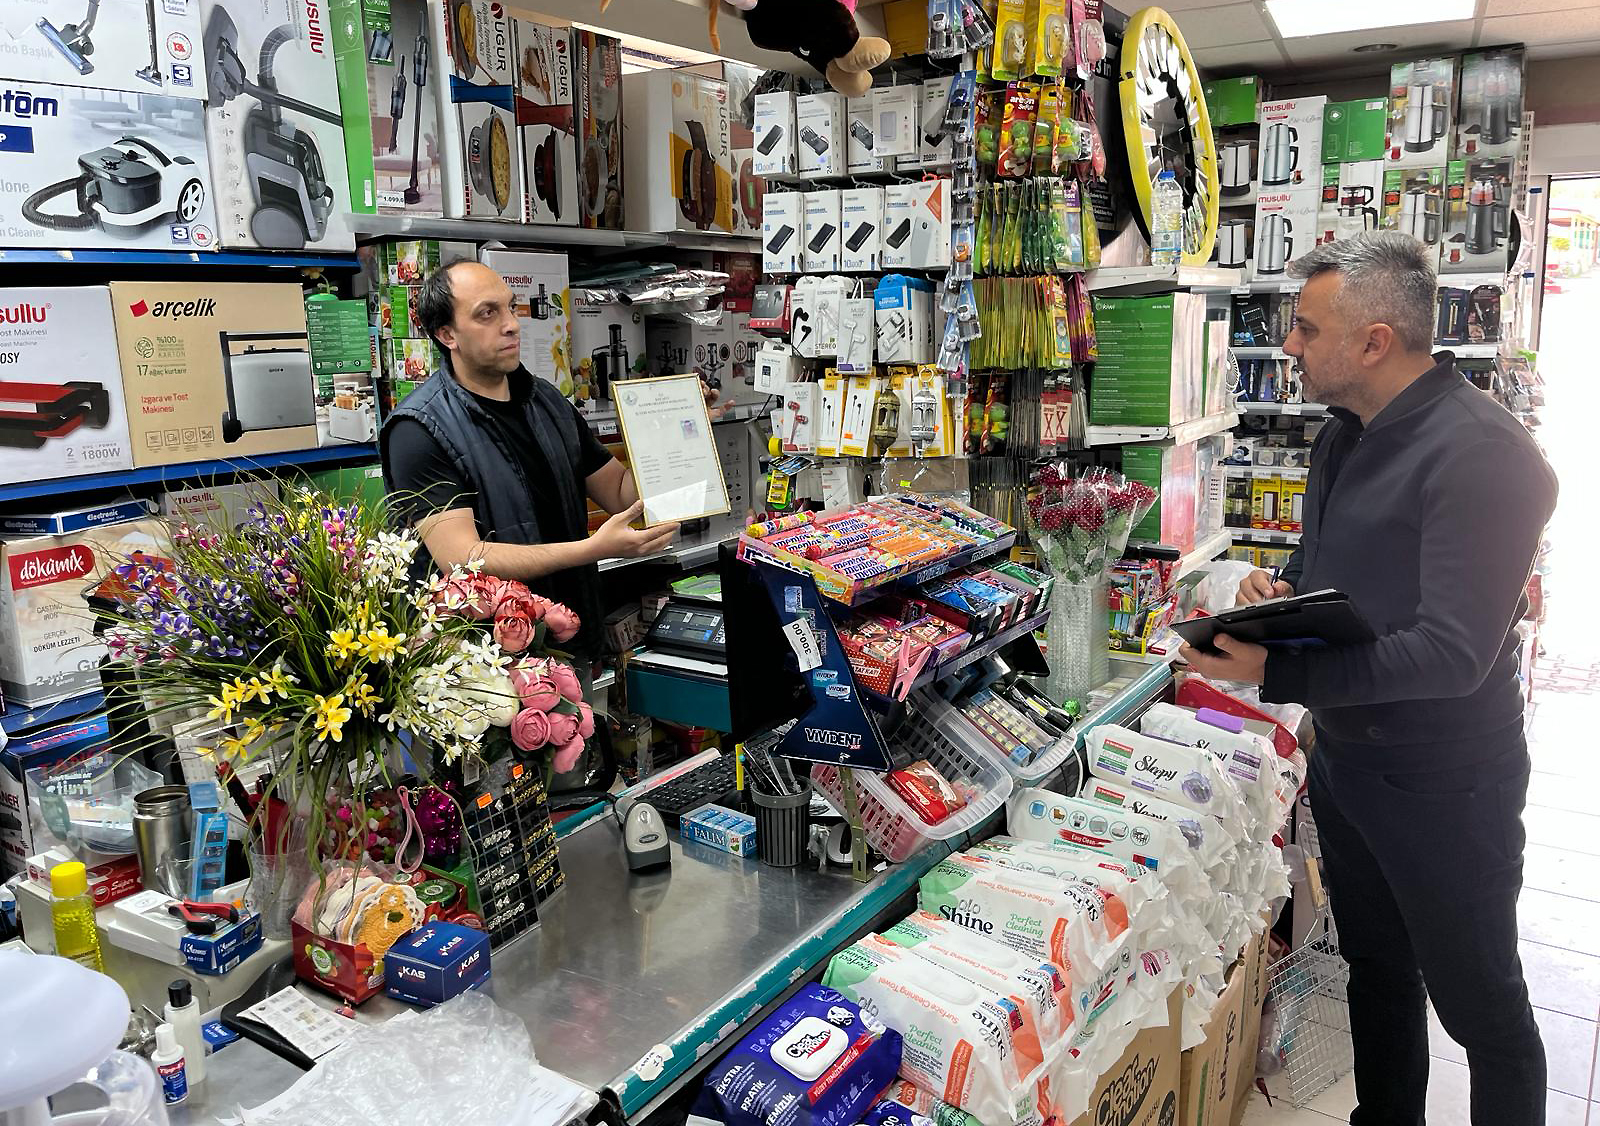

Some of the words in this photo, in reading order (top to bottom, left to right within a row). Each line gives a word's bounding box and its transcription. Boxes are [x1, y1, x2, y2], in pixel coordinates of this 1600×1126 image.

[1263, 102, 1296, 112] musullu
[1258, 194, 1291, 203] musullu
[502, 276, 532, 284] musullu
[152, 298, 216, 321] arçelik
[137, 364, 148, 376] 17
[174, 393, 188, 401] Tost
[67, 448, 74, 457] 2
[81, 447, 120, 460] 1800W
[87, 508, 118, 520] Electronic
[4, 520, 38, 528] Electronic
[827, 518, 859, 530] mentos
[832, 555, 866, 570] mentos
[844, 558, 878, 574] mentos
[854, 564, 888, 580] mentos
[36, 604, 63, 614] CASTING
[44, 630, 68, 640] GERÇEK
[792, 623, 812, 654] 300,00
[805, 728, 862, 747] VIVIDENT
[1134, 755, 1178, 782] Sleepy
[694, 826, 727, 848] FALIM
[1028, 894, 1056, 906] Surface
[940, 904, 994, 934] Shine
[1010, 913, 1042, 926] Perfect
[1006, 921, 1044, 938] Cleaning
[440, 936, 462, 954] KAS
[460, 950, 480, 970] KAS
[402, 966, 426, 980] KAS
[878, 976, 900, 992] Towel
[900, 986, 932, 1009] Cleaning
[930, 1002, 960, 1024] Surface
[806, 1030, 832, 1054] motion
[909, 1024, 942, 1044] Perfect
[786, 1034, 815, 1058] Clear
[904, 1032, 944, 1059] Cleaning
[716, 1064, 743, 1096] EKSTRA
[740, 1079, 766, 1112] PRATİK
[765, 1091, 796, 1126] TEMİZLİK
